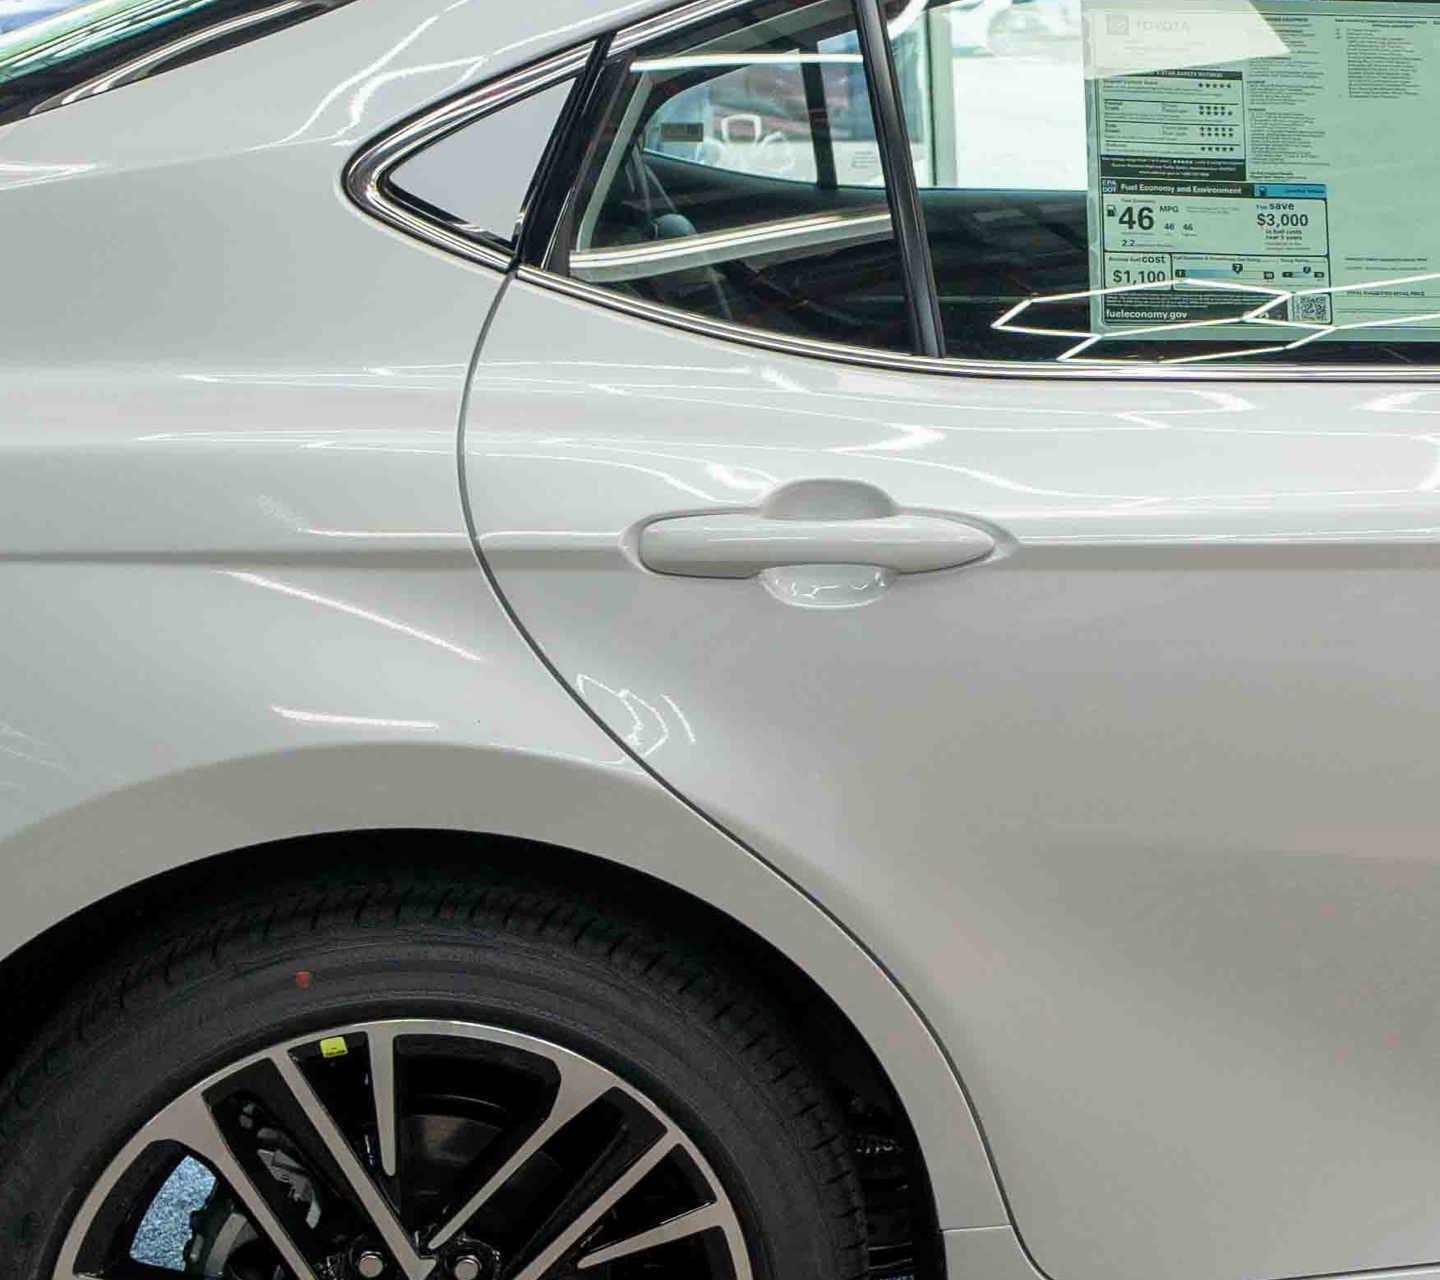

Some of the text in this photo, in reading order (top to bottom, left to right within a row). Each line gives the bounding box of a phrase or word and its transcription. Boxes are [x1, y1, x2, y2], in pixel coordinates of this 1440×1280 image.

[1121, 183, 1242, 194] Fuel Economy and Environment
[1269, 202, 1295, 211] save
[1118, 206, 1155, 231] 46
[1159, 205, 1179, 213] MPG
[1256, 213, 1309, 228] $3,000
[1121, 239, 1136, 247] 2.2
[1142, 255, 1166, 264] cost
[1112, 269, 1166, 285] $1,100
[1105, 309, 1188, 319] fueleconomy.gov
